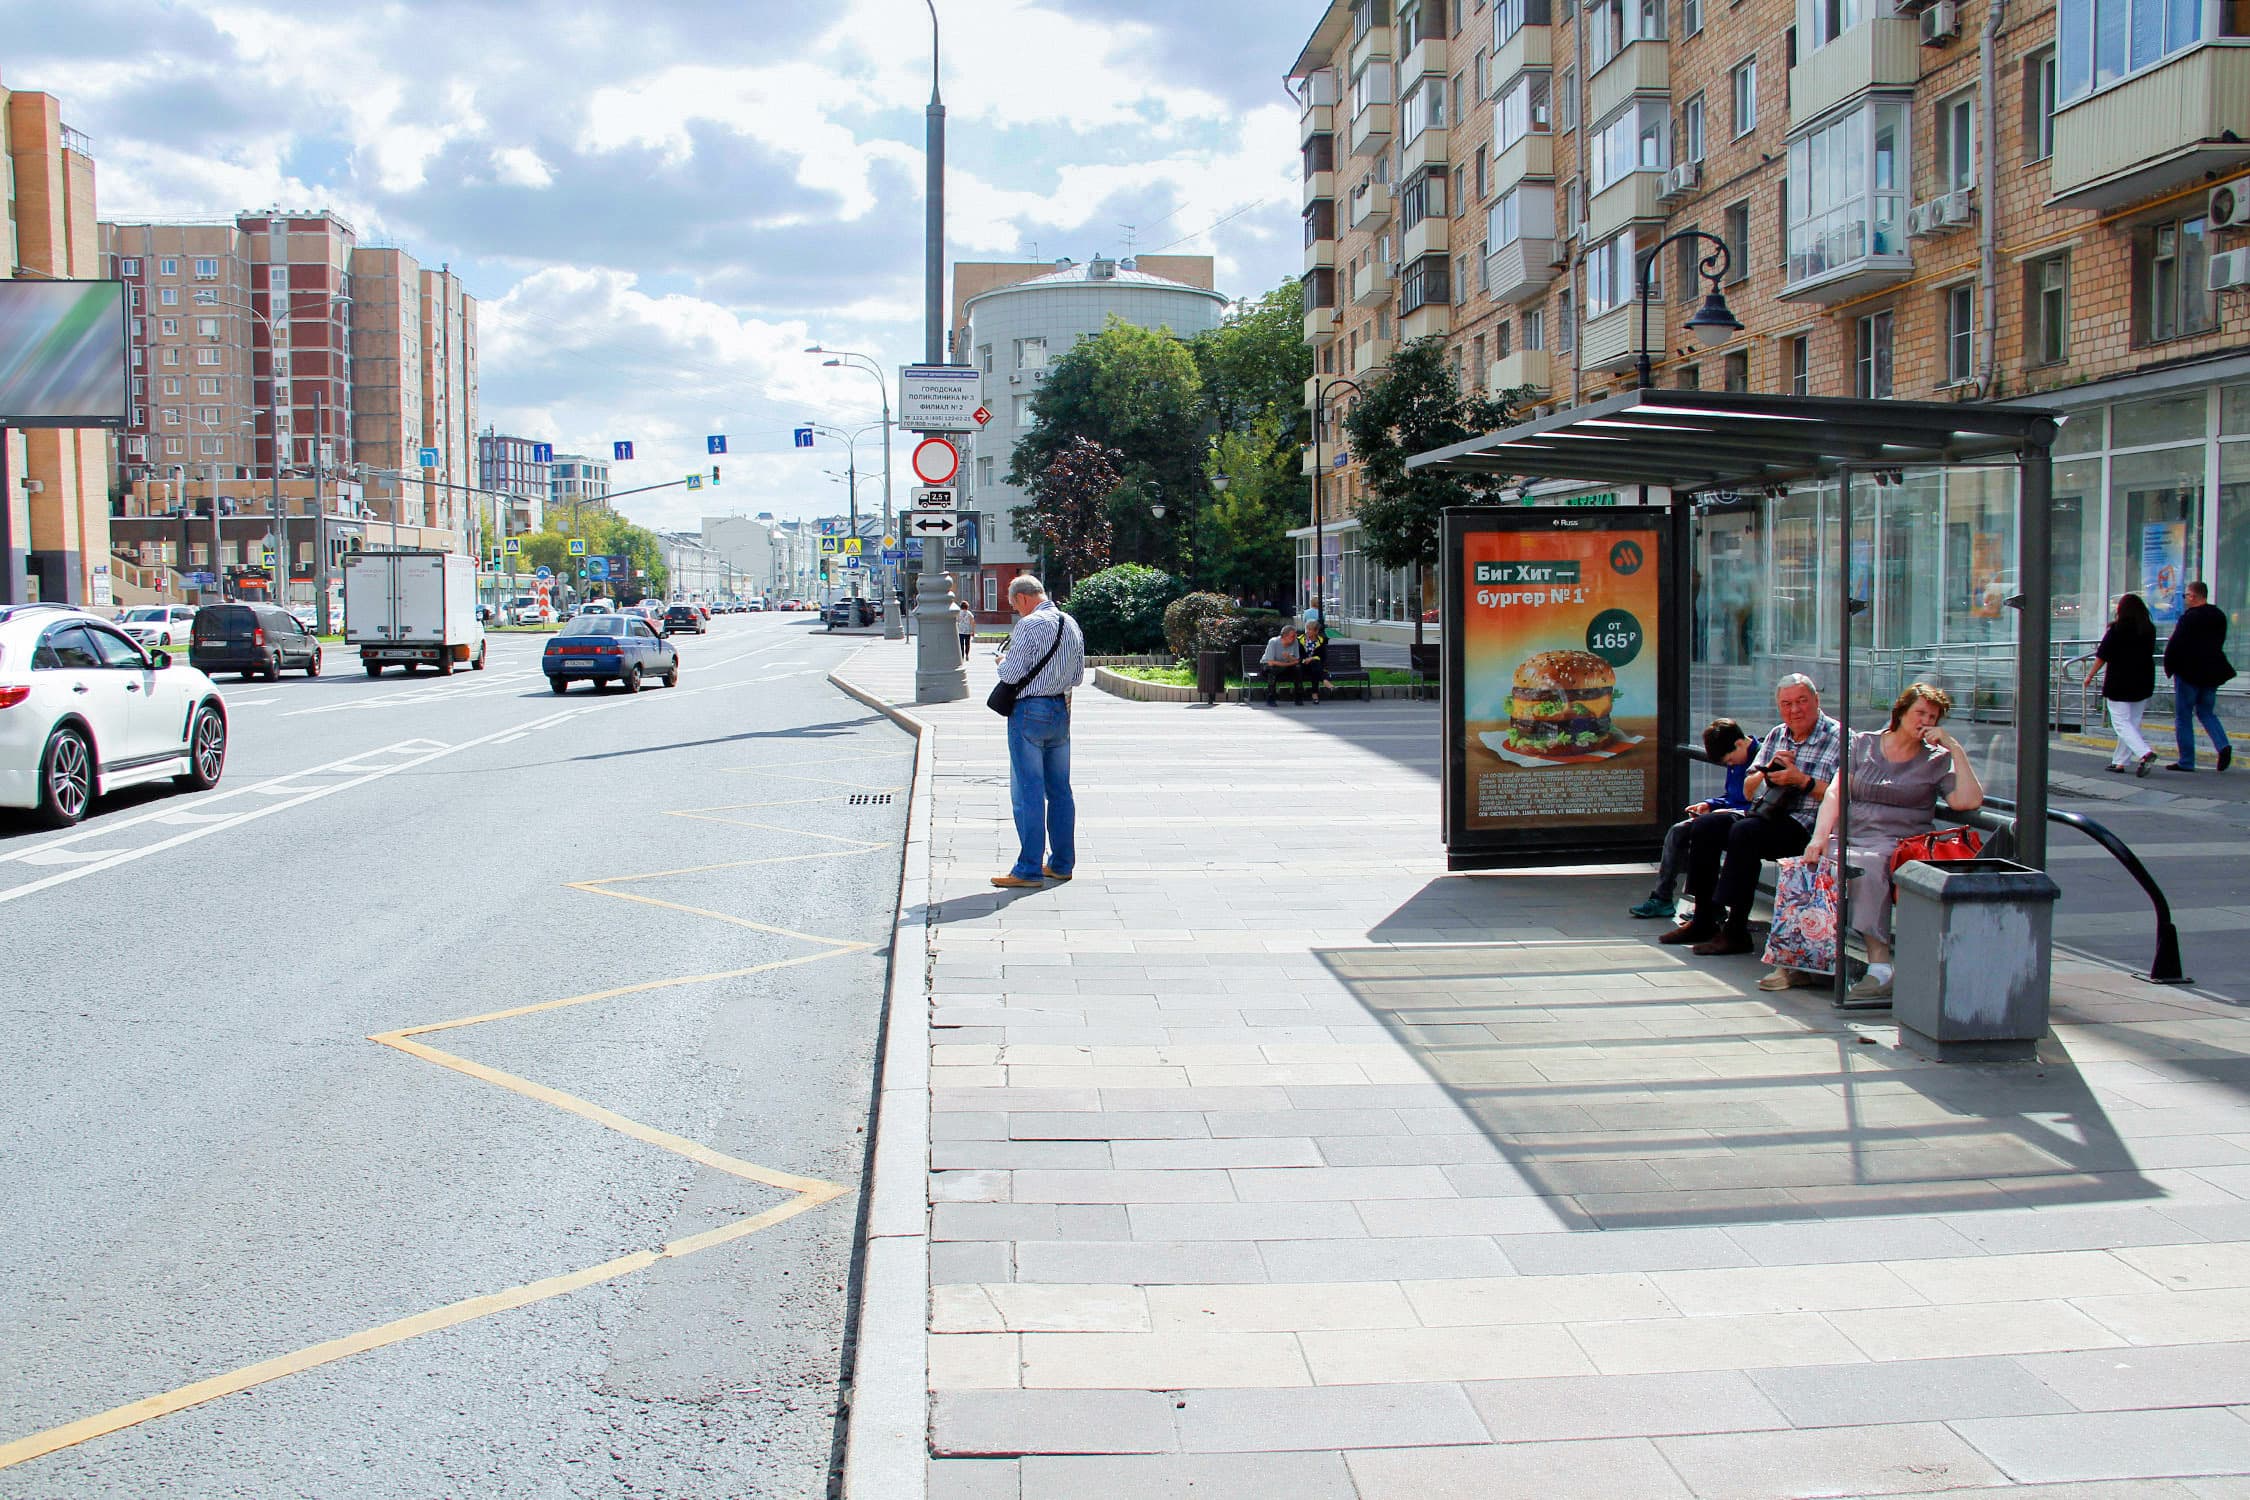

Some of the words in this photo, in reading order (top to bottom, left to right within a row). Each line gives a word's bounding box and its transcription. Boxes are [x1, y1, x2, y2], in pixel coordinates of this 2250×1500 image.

[1477, 566, 1513, 582] Биг
[1515, 564, 1553, 581] Хит
[1476, 589, 1546, 609] бургер
[1550, 588, 1570, 605] №
[1607, 622, 1622, 631] от
